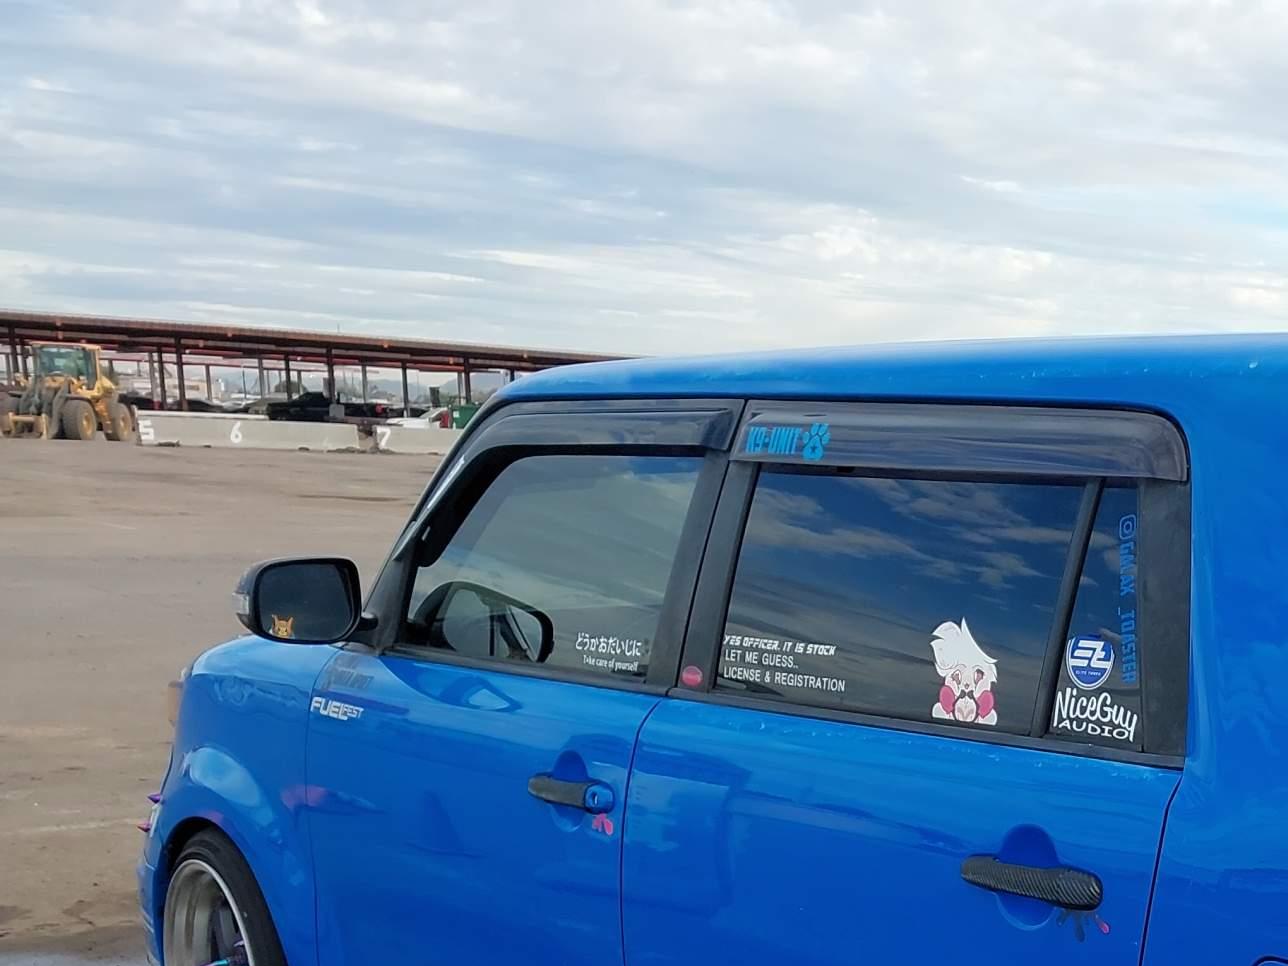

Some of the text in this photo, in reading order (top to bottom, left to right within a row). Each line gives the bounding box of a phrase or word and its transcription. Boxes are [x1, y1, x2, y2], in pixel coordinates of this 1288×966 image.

[139, 420, 154, 440] 5
[230, 422, 242, 443] 6
[377, 426, 392, 449] 7
[723, 635, 742, 646] YES
[783, 641, 793, 652] IT
[795, 642, 806, 654] IS
[806, 643, 837, 656] STOCK
[596, 658, 607, 668] care
[608, 658, 615, 669] of
[615, 661, 639, 672] yourself
[725, 649, 742, 662] LET
[745, 651, 758, 664] ME
[723, 666, 846, 692] LICENSE & REGISTRATION
[1053, 687, 1138, 742] NiceGuy
[1059, 720, 1129, 739] AUDIO
